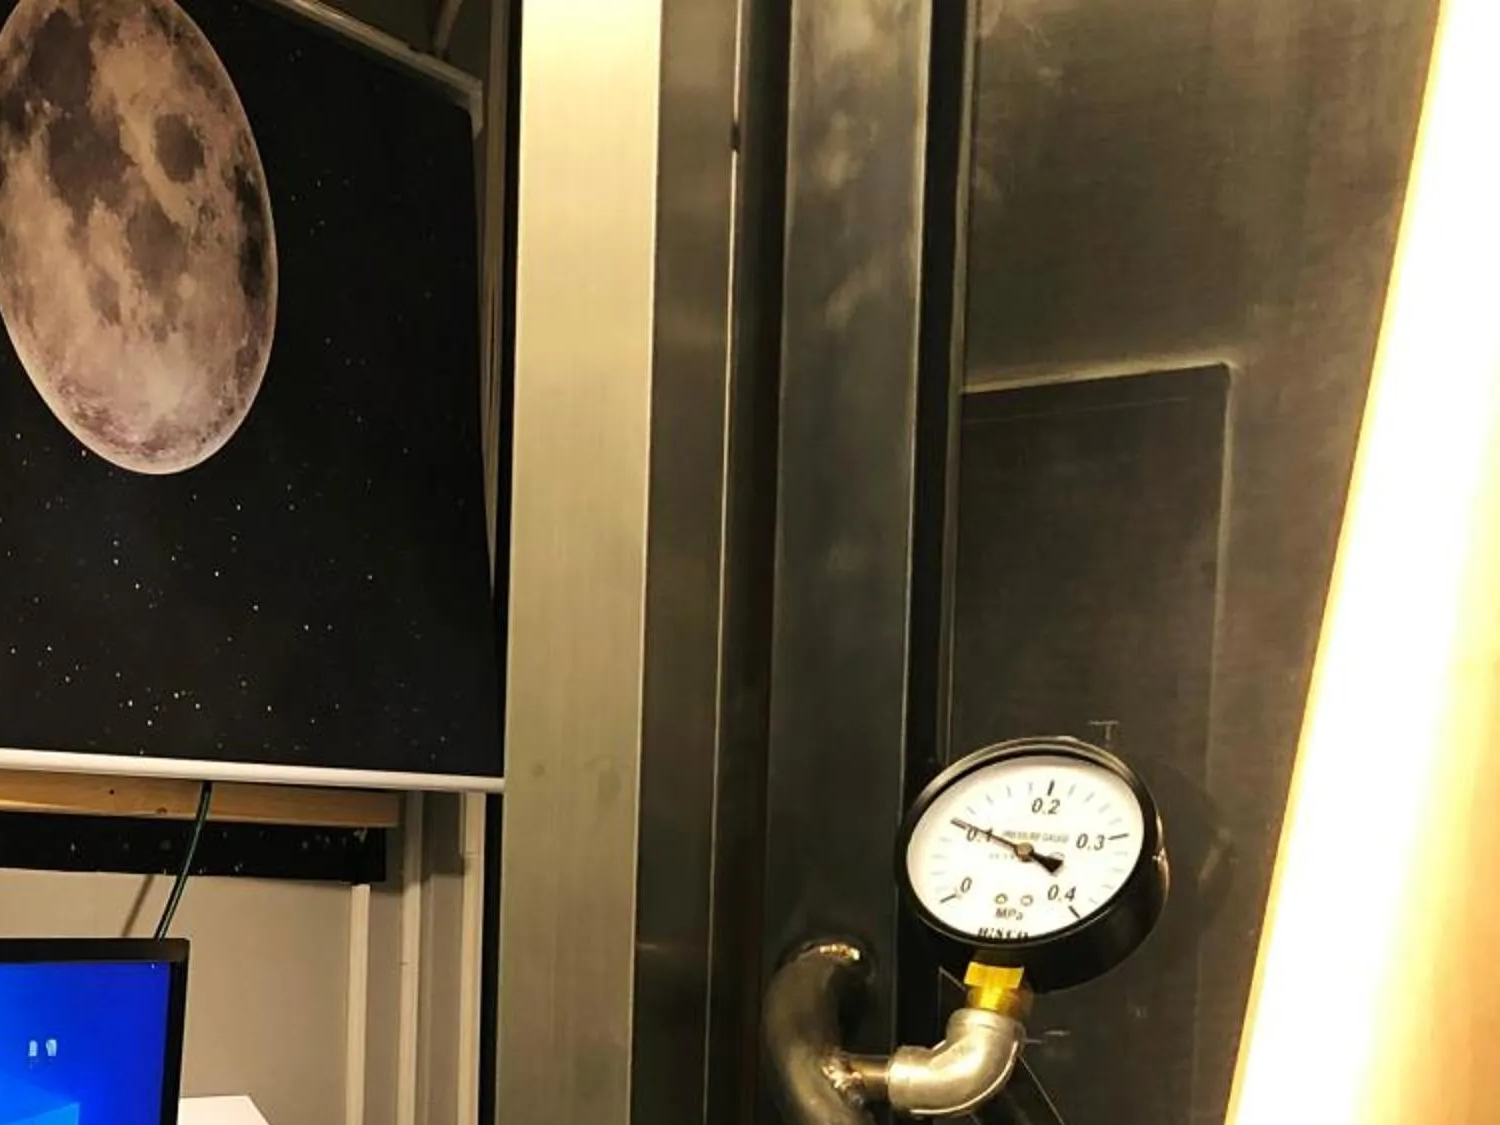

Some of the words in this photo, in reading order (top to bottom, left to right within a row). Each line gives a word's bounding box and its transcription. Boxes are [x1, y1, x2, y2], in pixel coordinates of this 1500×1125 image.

[1031, 797, 1061, 815] 0.2
[966, 825, 993, 842] 0.1
[1076, 833, 1105, 851] 0.3
[960, 876, 972, 894] 0
[1047, 884, 1077, 901] 0.4
[995, 907, 1023, 920] MPa
